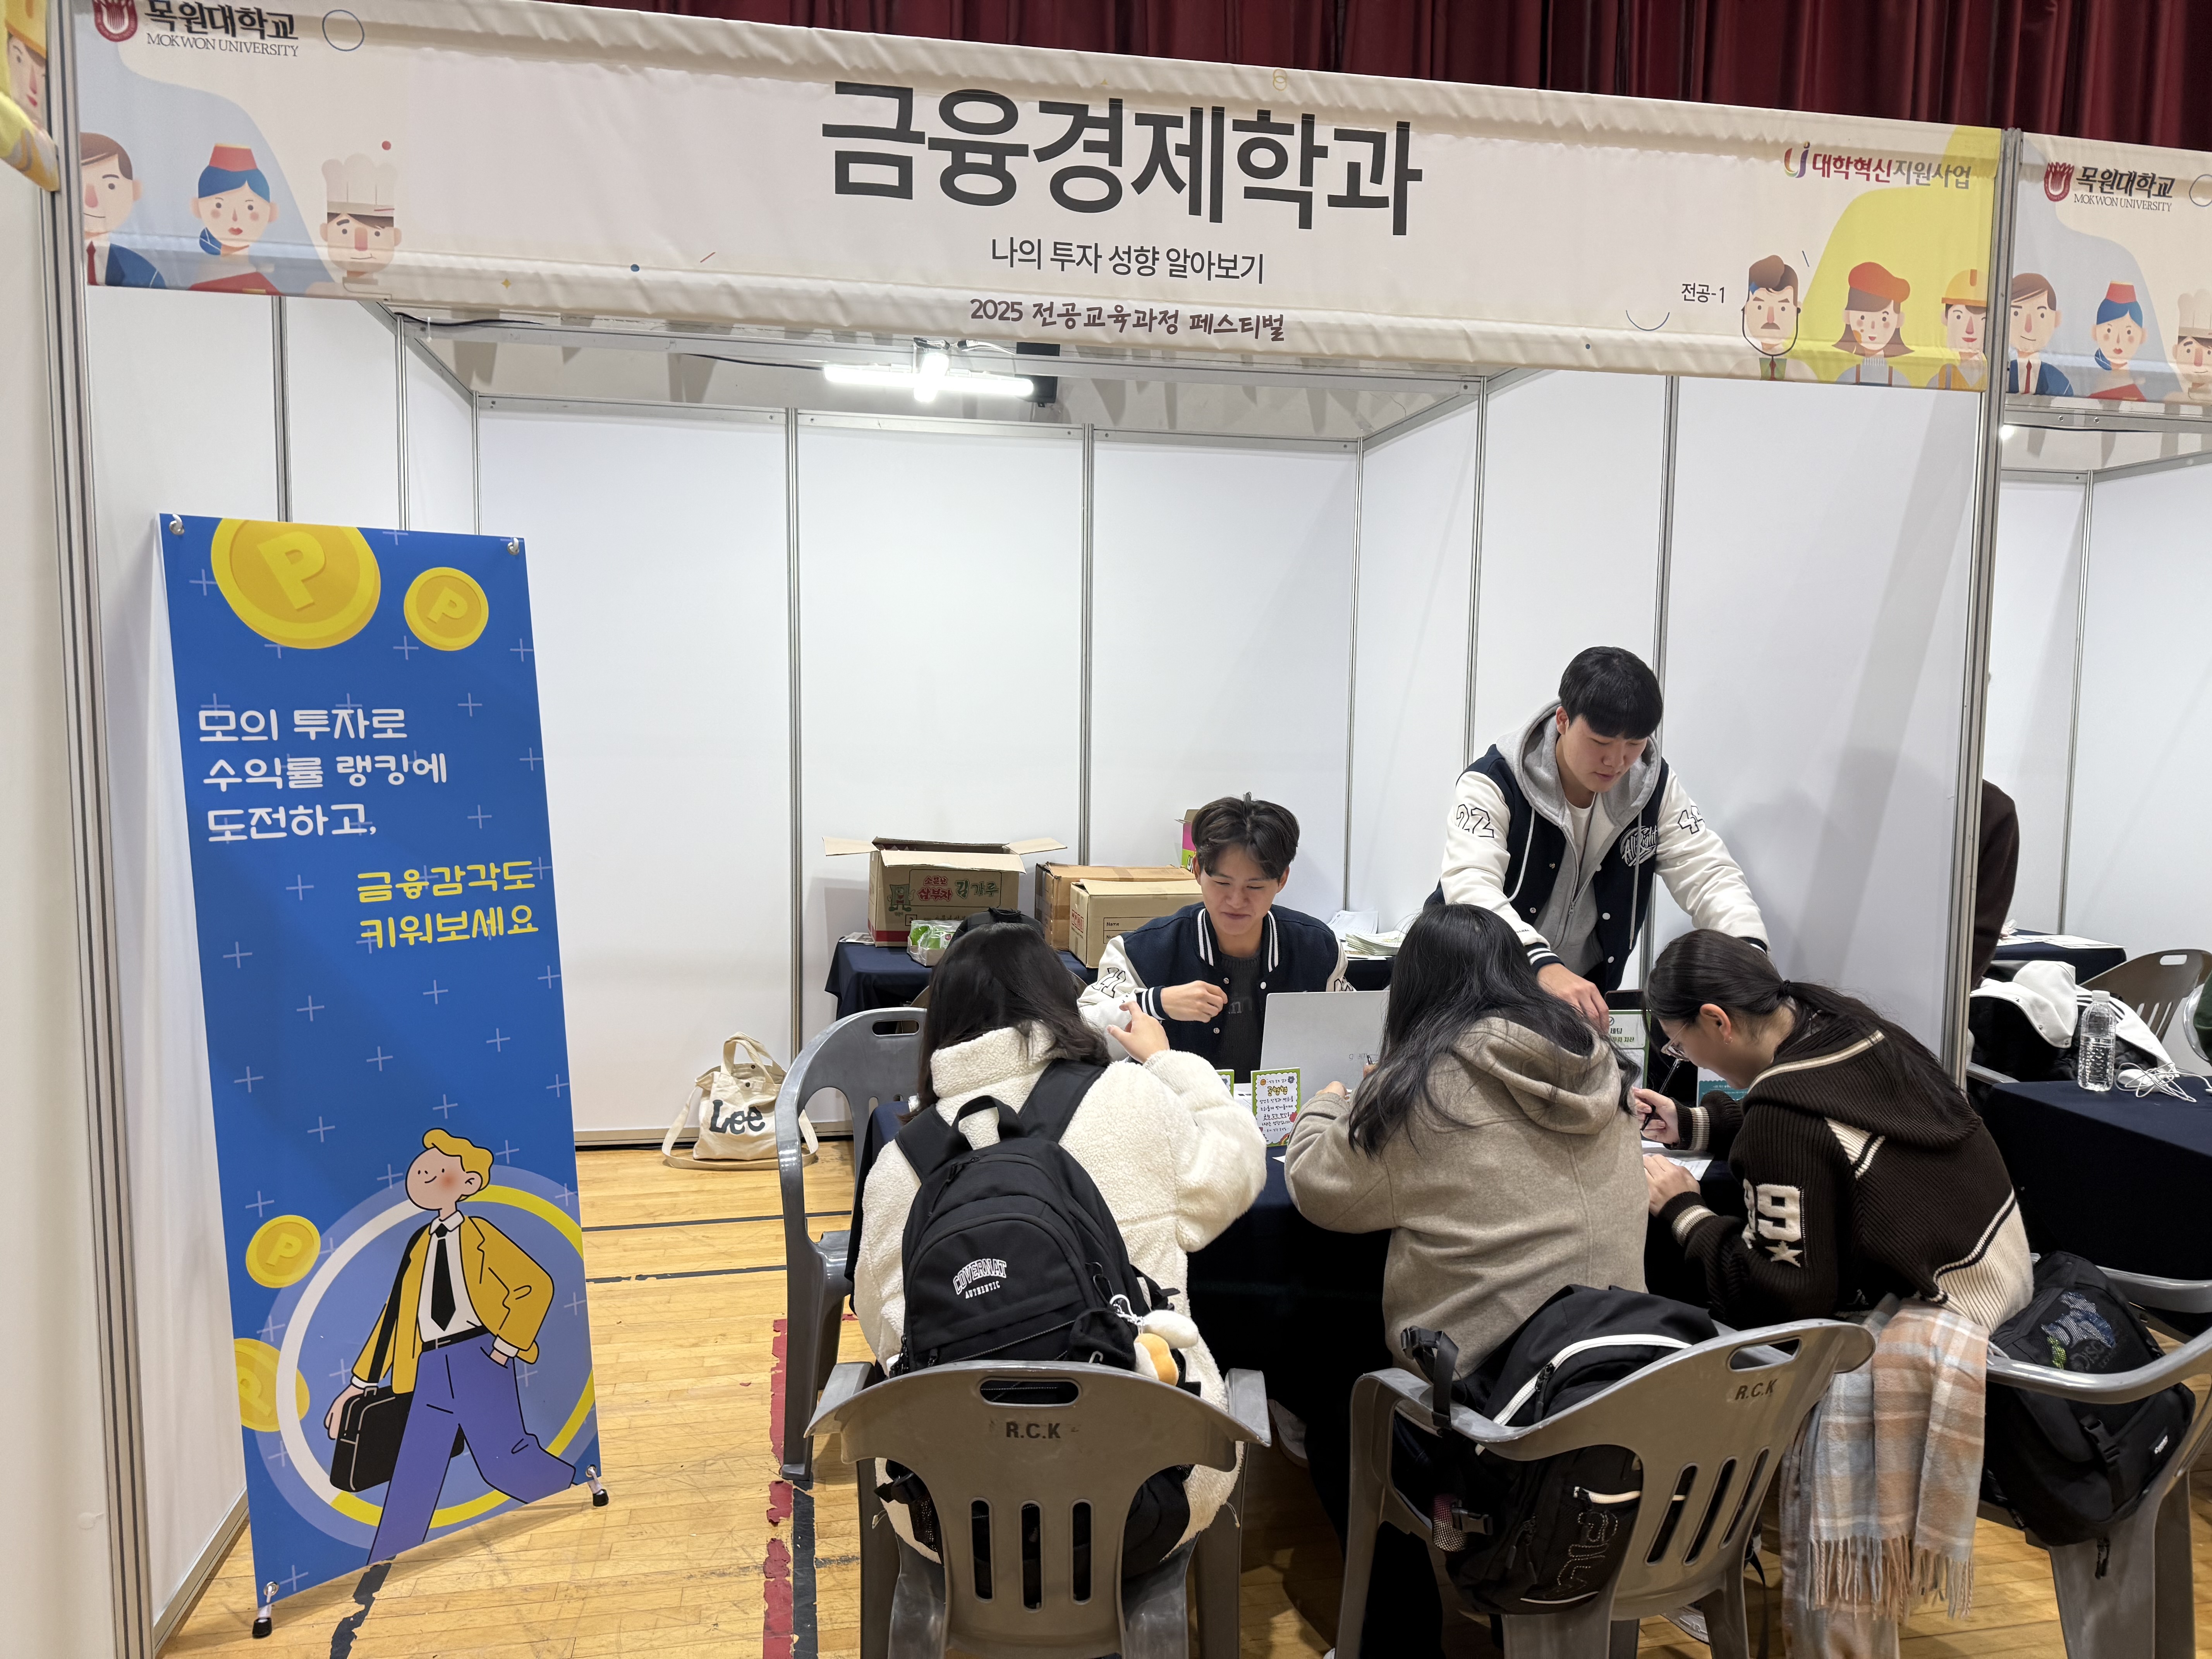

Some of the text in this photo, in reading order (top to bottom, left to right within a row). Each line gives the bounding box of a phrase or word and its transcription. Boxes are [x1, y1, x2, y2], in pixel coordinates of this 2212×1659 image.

[145, 0, 298, 40] 목원대학교
[147, 33, 298, 57] MOKWON UNIVERSITY
[822, 81, 1422, 235] 금융경제학과
[1812, 153, 1972, 189] 대학혁신지원사업
[2076, 167, 2175, 198] 목원대학교
[2074, 194, 2172, 211] MOKWON UNIVERSITY
[992, 237, 1263, 284] 나의 투자 성향 알아보기
[1681, 283, 1725, 304] 전공-1
[970, 299, 1285, 342] 2025 전공교육과정 페스티벌
[199, 709, 407, 741] 모의 투자로
[203, 753, 447, 792] 수익률 랭킹에
[208, 804, 376, 842] 도전하고,
[357, 861, 535, 903] 금융감각도
[917, 887, 953, 902] 삼부자
[924, 876, 948, 886] 소문난
[360, 905, 539, 948] 키워보세요
[709, 1099, 766, 1135] Lee
[953, 1258, 1008, 1296] COVERNAT
[965, 1281, 1001, 1299] AUTHENTIC
[1734, 1378, 1778, 1401] R.C.K
[1006, 1421, 1061, 1439] R.C.K
